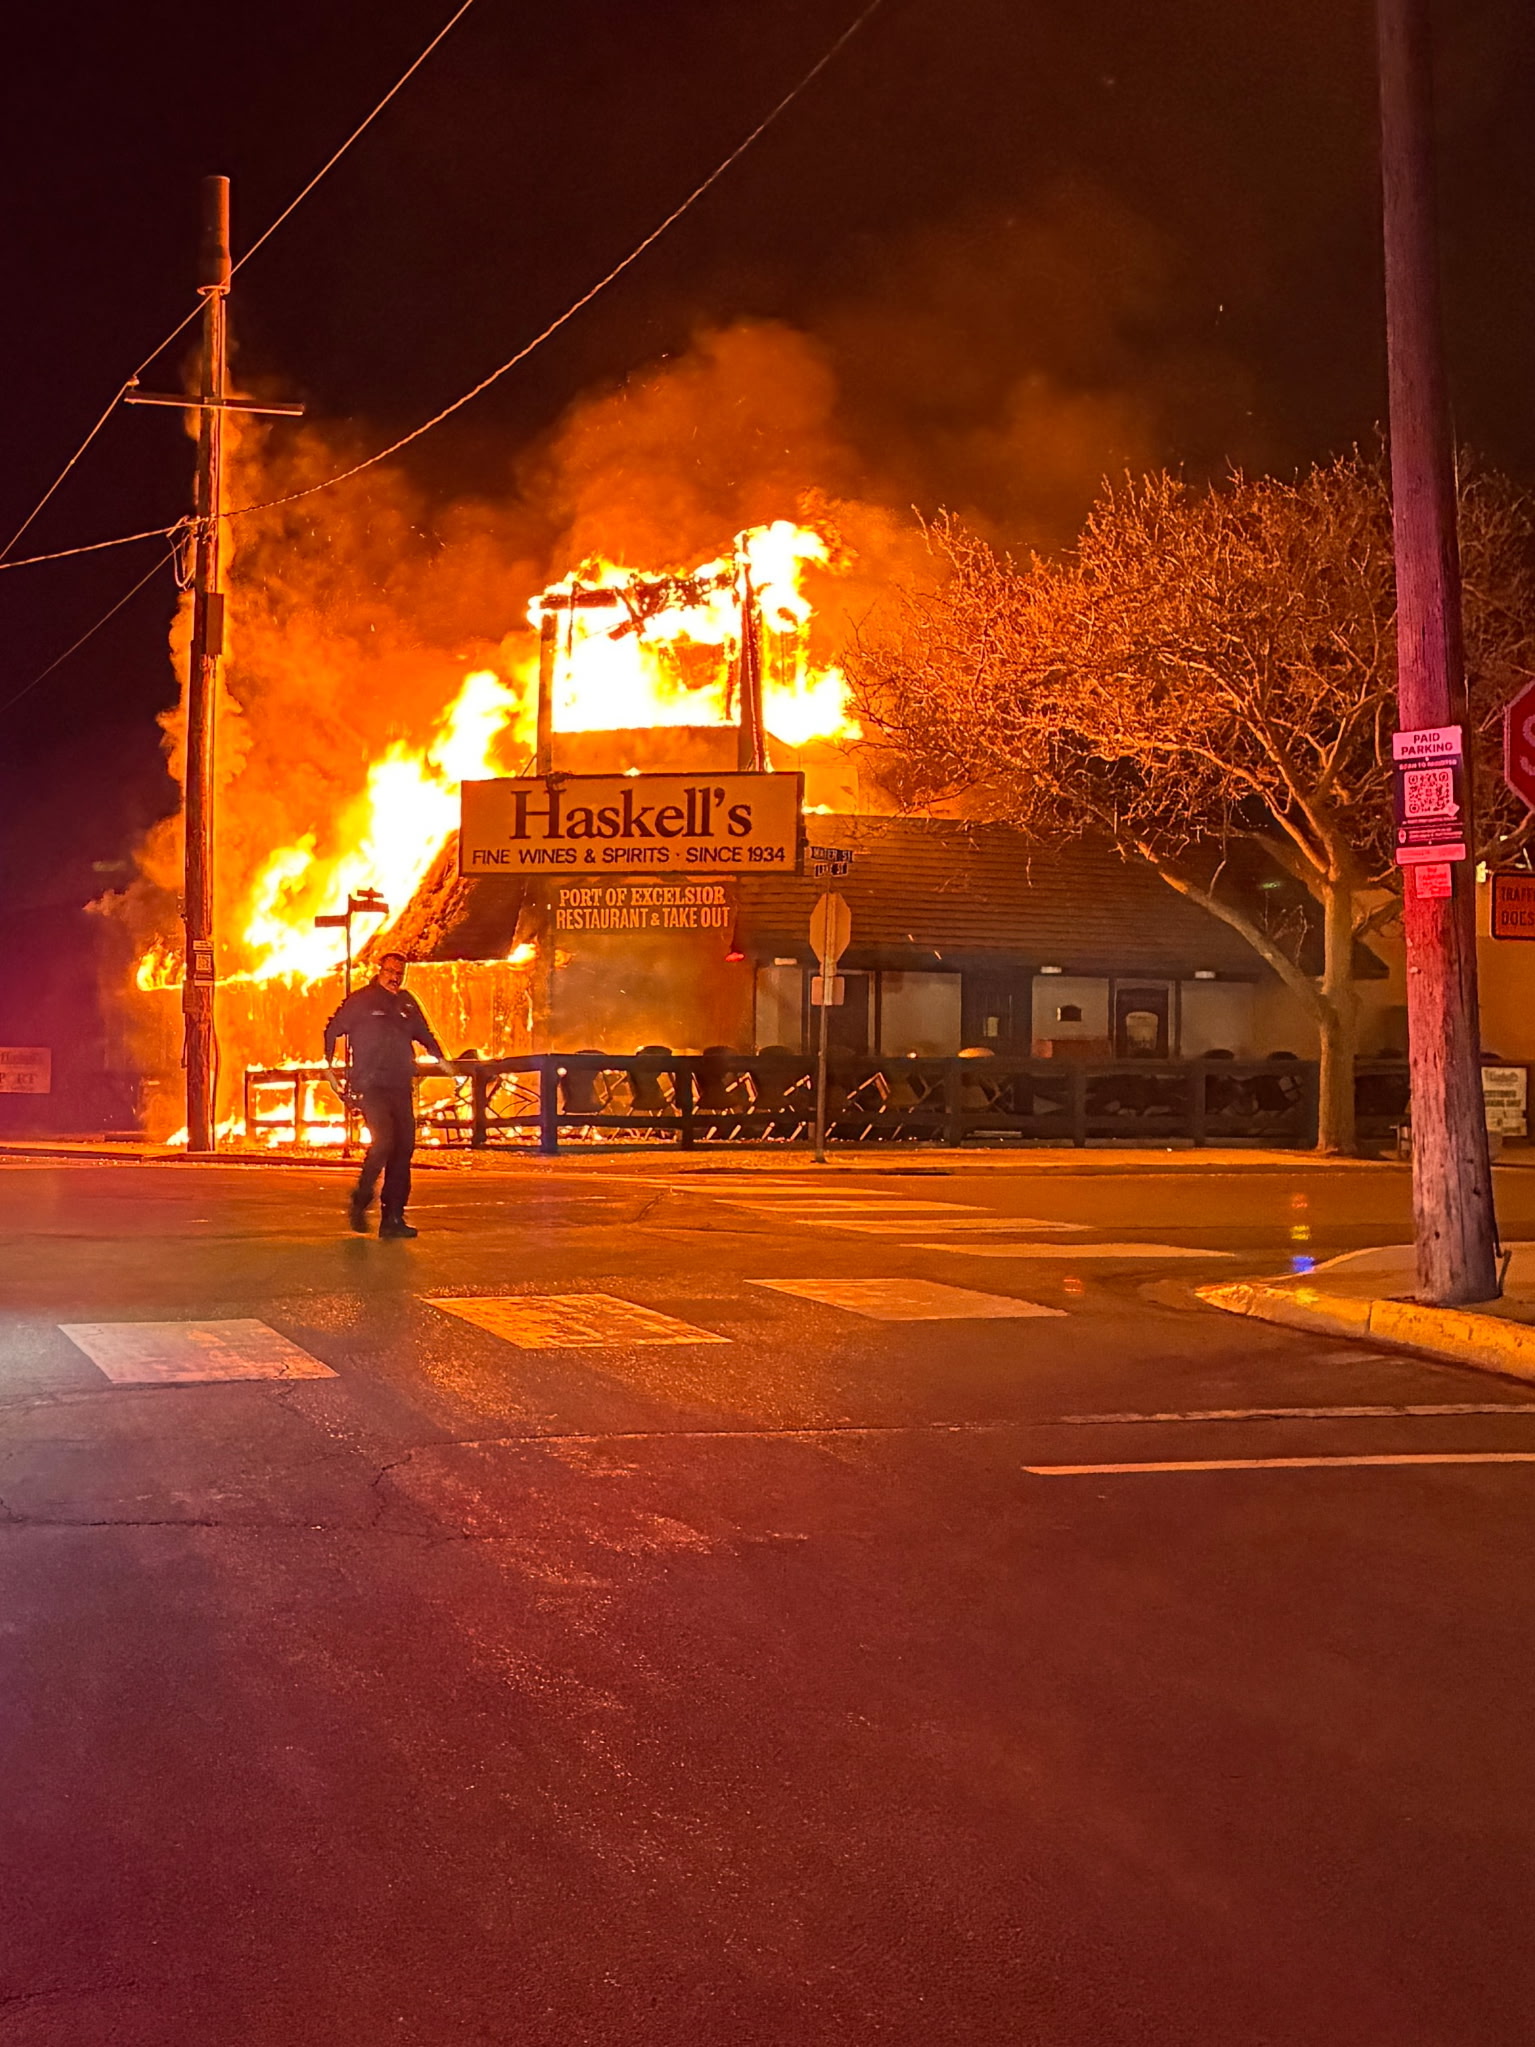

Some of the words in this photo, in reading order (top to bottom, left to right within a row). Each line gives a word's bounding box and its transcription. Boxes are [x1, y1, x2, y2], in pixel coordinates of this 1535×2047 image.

[1413, 732, 1441, 744] PAID
[1401, 742, 1453, 755] PARKING
[509, 787, 752, 839] Haskell's
[472, 850, 511, 864] FINE
[519, 848, 577, 864] WINES
[584, 849, 596, 863] &
[602, 847, 670, 863] SPIRITS
[685, 846, 743, 863] SINCE
[748, 846, 785, 862] 1934
[559, 888, 602, 907] PORT
[605, 887, 628, 906] OF
[631, 886, 726, 906] EXCELSIOR
[556, 908, 649, 930] RESTAURANT
[650, 912, 661, 926] &
[662, 907, 698, 928] TAKE
[701, 906, 730, 928] OUT
[1502, 911, 1535, 926] DOES
